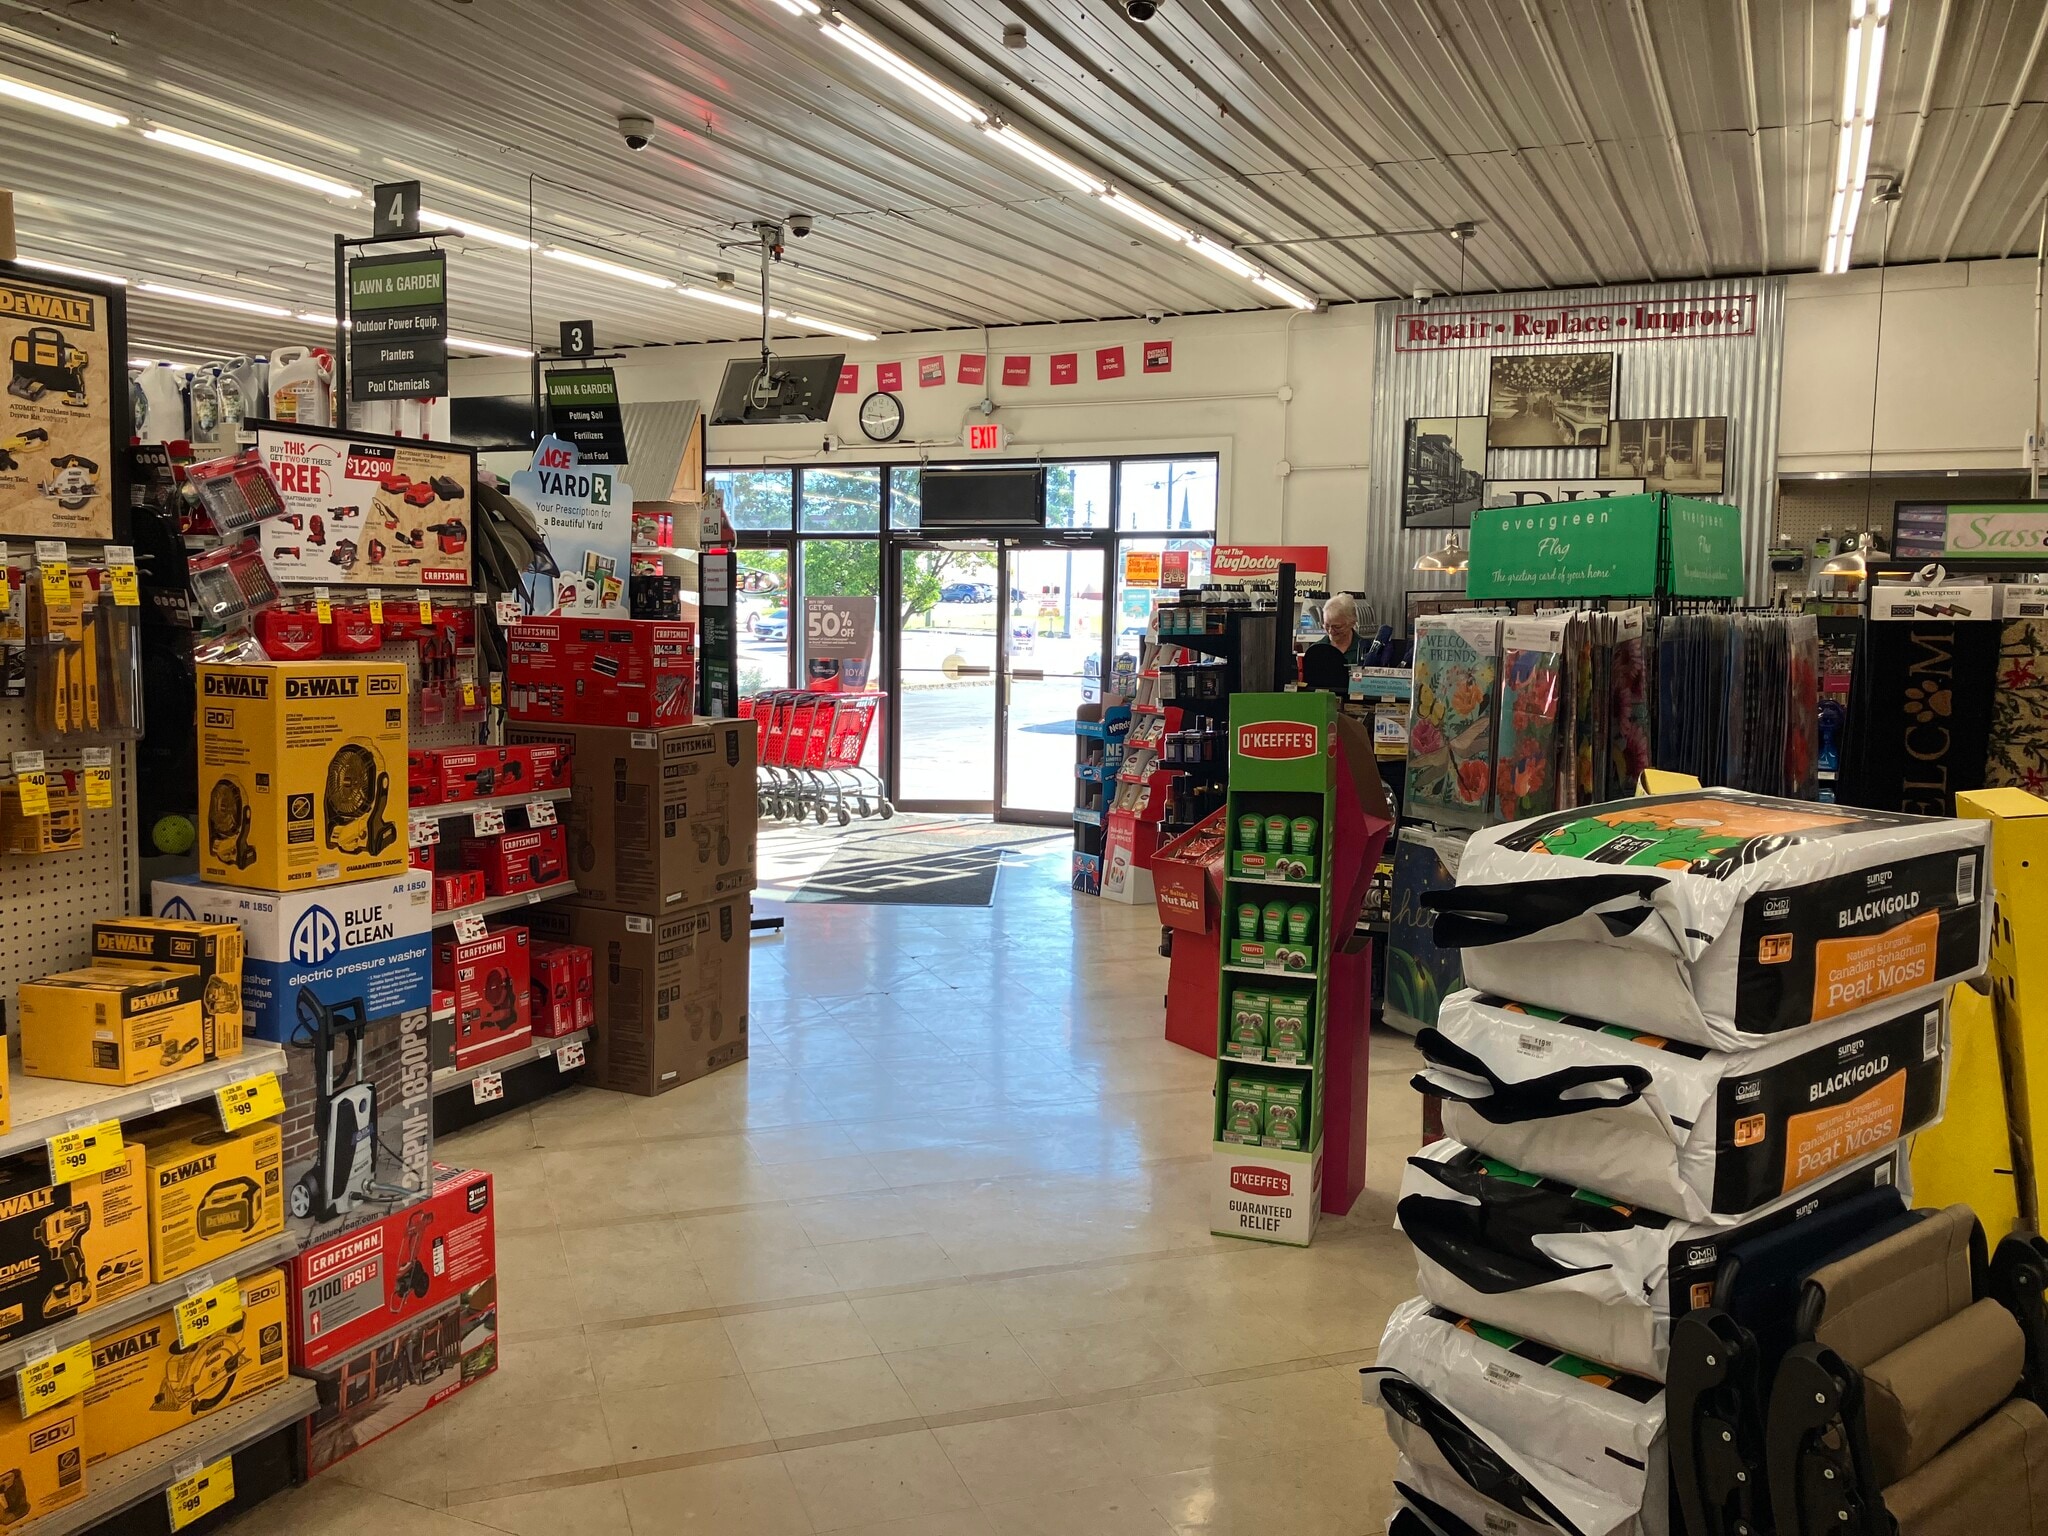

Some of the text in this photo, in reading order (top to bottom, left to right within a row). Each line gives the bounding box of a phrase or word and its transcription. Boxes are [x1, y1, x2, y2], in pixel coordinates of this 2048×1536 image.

[388, 192, 405, 227] 4
[353, 273, 440, 295] LAWN & GARDEN
[356, 316, 440, 332] Outdoor Power Equip.
[1408, 306, 1741, 344] Repair Replace Improve
[571, 327, 583, 352] 3
[380, 349, 414, 361] Planters
[1056, 364, 1071, 372] RIGHT
[1102, 363, 1119, 371] STORE
[368, 379, 430, 393] Pool Chemicals
[549, 383, 613, 396] LAWN & GARDEN
[70, 410, 91, 418] Impact
[569, 410, 604, 421] Potting Soil
[574, 431, 604, 440] Fertilizers
[970, 425, 998, 450] EXIT
[270, 441, 305, 456] BUY THIS
[364, 448, 381, 456] SALE
[578, 451, 609, 460] Plant Food
[269, 454, 332, 467] GET TWO OF THESE
[538, 446, 572, 469] ACE
[270, 462, 321, 494] FREE
[538, 470, 590, 498] YARD
[536, 501, 612, 518] Your Prescription for
[551, 516, 586, 529] Beautiful
[587, 519, 603, 531] Yard
[1502, 511, 1609, 531] evergreen
[1682, 510, 1724, 528] evergreen
[1214, 548, 1244, 556] Rent The
[1538, 537, 1571, 562] Flag
[424, 571, 465, 581] CRAFTSMAN
[1239, 578, 1266, 586] Complete
[1492, 564, 1610, 586] The greeting card of your home
[1922, 589, 1961, 598] evergreen
[513, 628, 557, 638] CRAFTSMAN
[656, 630, 689, 640] CRAFTSMAN
[840, 628, 855, 637] OFF
[511, 641, 524, 652] 104
[654, 645, 665, 655] 104
[1430, 649, 1477, 662] FRIENDS
[204, 676, 269, 697] DEWALT
[285, 677, 359, 698] DEWALT
[369, 678, 399, 692] 20V
[206, 711, 232, 725] 20V
[790, 727, 803, 736] ACE
[666, 740, 714, 754] CRAFTSMAN
[1242, 733, 1313, 749] O'KEEFFE'S
[444, 756, 475, 767] CRAFTSMAN
[531, 750, 556, 758] CRAFTSMAN
[93, 769, 110, 780] $20
[664, 766, 678, 776] GAS
[27, 774, 45, 786] $40
[504, 836, 539, 849] CRAFTSMAN
[346, 861, 382, 872] GUARANTEED
[1866, 870, 1892, 886] sungro
[393, 880, 427, 894] AR 1850
[1169, 890, 1188, 898] Salted
[239, 900, 273, 913] AR 1850
[1160, 894, 1199, 910] Nut Roll
[1765, 899, 1790, 912] OMRI
[344, 905, 383, 927] BLUE
[1838, 893, 1920, 928] BLACK GOLD
[97, 933, 154, 953] DEWALT
[294, 916, 337, 962] AR
[345, 923, 394, 947] CLEAN
[174, 940, 192, 952] 20V
[459, 938, 504, 962] CRAFTSMAN
[1846, 934, 1913, 962] Natural & Organic
[288, 946, 426, 987] electric pressure washer
[1829, 942, 1927, 982] Canadian Sphagnum
[1827, 958, 1926, 1009] Peat Moss
[131, 987, 179, 1013] DEWALT
[204, 1017, 213, 1054] DEWALT
[1838, 1039, 1864, 1056] sungro
[1809, 1055, 1889, 1102] BLACK GOLD
[1736, 1083, 1761, 1096] OMRI
[233, 1102, 252, 1116] $99
[1815, 1098, 1881, 1133] Natural & Organic
[1798, 1103, 1894, 1155] Canadian Sphagnum
[1796, 1119, 1892, 1179] Peat Moss
[66, 1153, 87, 1167] $99
[160, 1156, 216, 1188] DEWALT
[1233, 1172, 1288, 1191] O'KEEFFE'S
[468, 1185, 486, 1201] 3 YEAR
[0, 1188, 52, 1216] WALT
[1229, 1200, 1292, 1219] GUARANTEED
[1796, 1198, 1819, 1220] sungro
[206, 1210, 240, 1228] DEWALT
[1240, 1214, 1281, 1232] RELIEF
[313, 1235, 380, 1273] CRAFTSMAN
[1688, 1248, 1716, 1262] OMRI
[250, 1286, 277, 1301] 20V
[308, 1268, 367, 1309] 2100 PSI
[191, 1315, 209, 1330] $99
[35, 1381, 56, 1397] $99
[33, 1424, 70, 1447] 20V
[182, 1495, 200, 1511] $99
